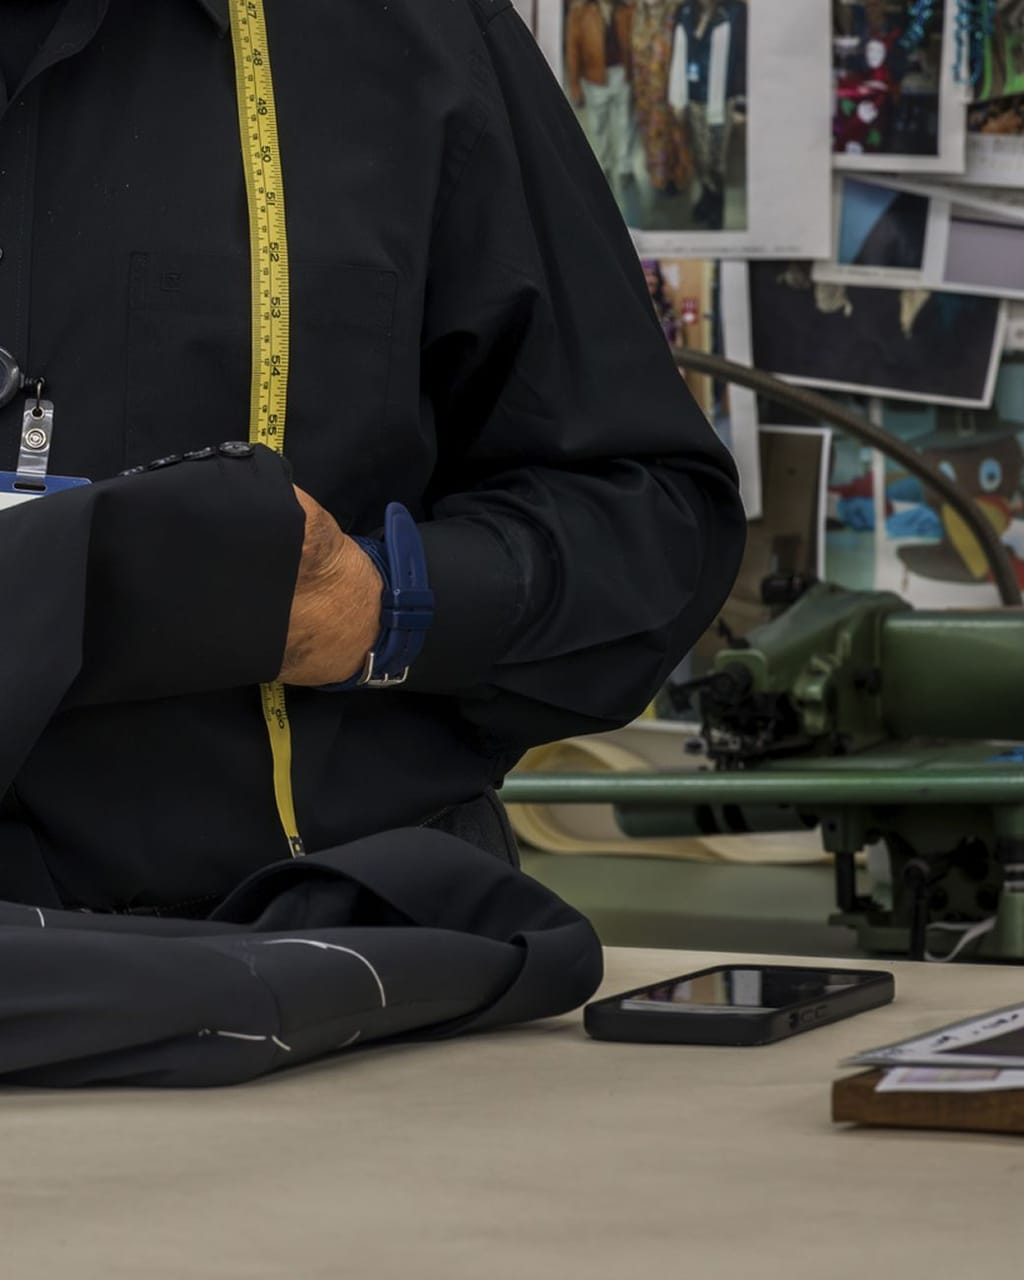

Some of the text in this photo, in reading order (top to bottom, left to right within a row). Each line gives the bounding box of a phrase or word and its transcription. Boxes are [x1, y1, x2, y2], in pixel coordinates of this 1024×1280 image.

[247, 1, 257, 19] 47
[253, 48, 263, 66] 48
[258, 98, 268, 115] 49
[261, 146, 271, 162] 50
[266, 192, 275, 205] 51
[269, 242, 279, 262] 52
[271, 297, 281, 318] 53
[271, 355, 281, 376] 54
[268, 414, 277, 435] 55
[276, 709, 284, 729] 60
